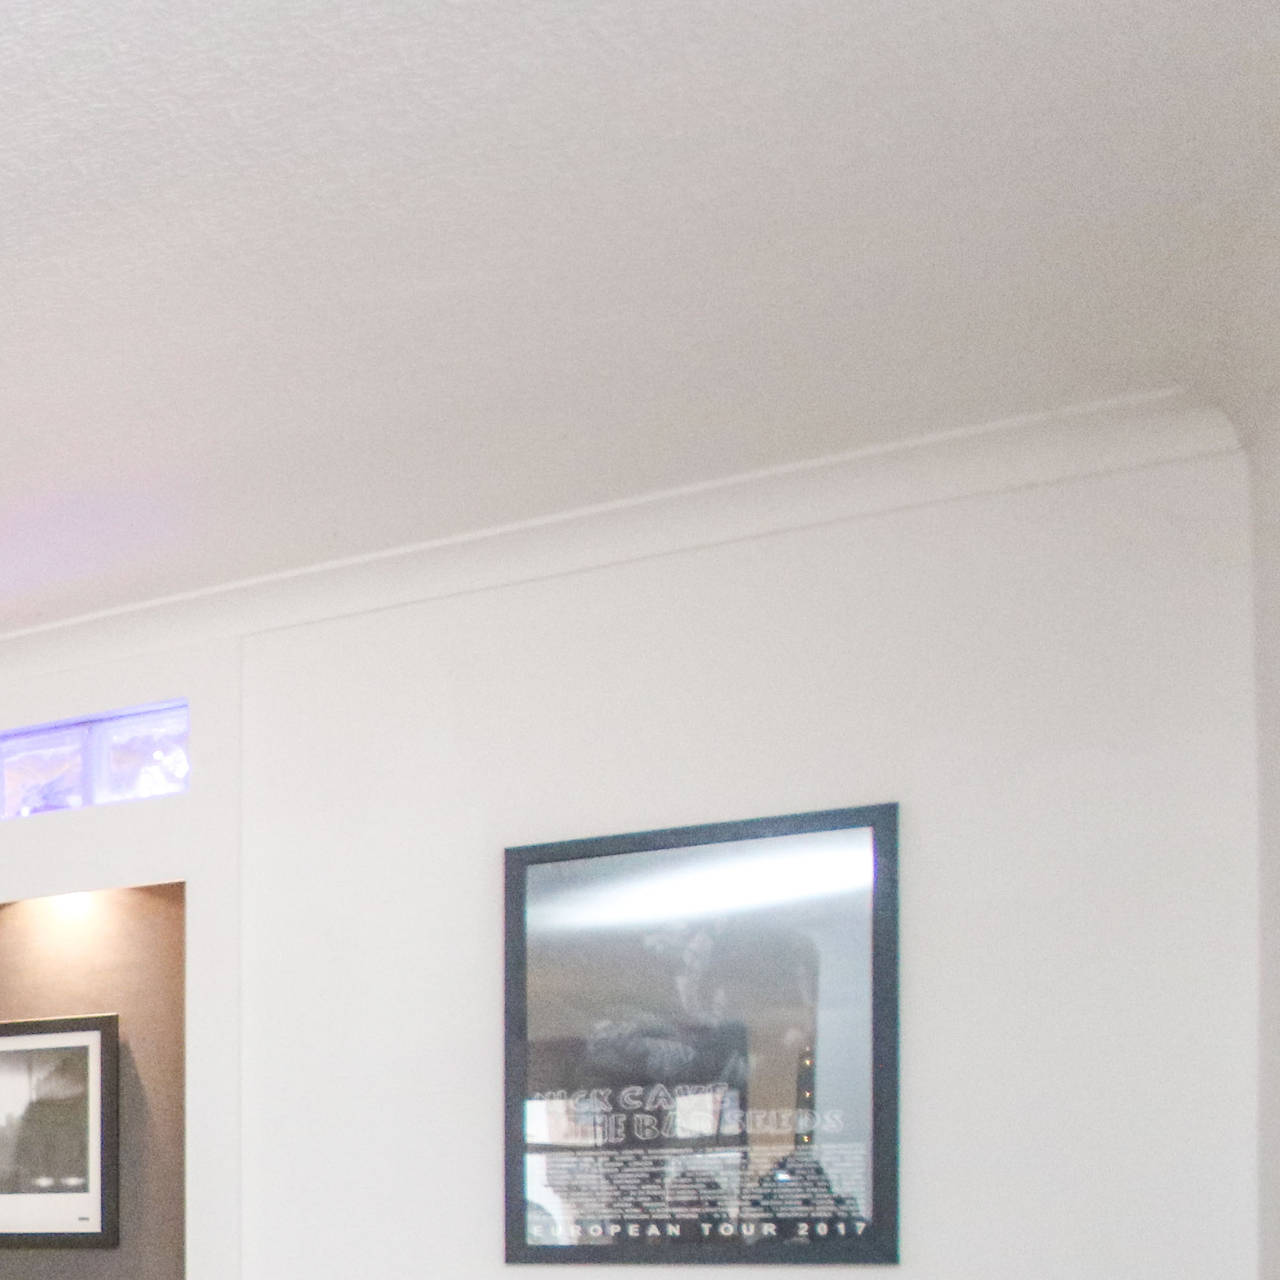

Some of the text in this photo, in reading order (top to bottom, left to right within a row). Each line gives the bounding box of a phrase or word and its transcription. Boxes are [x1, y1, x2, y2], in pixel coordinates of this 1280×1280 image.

[534, 1082, 730, 1114] CK CAE
[533, 1221, 868, 1238] EUROPEAN TOUR 2017
